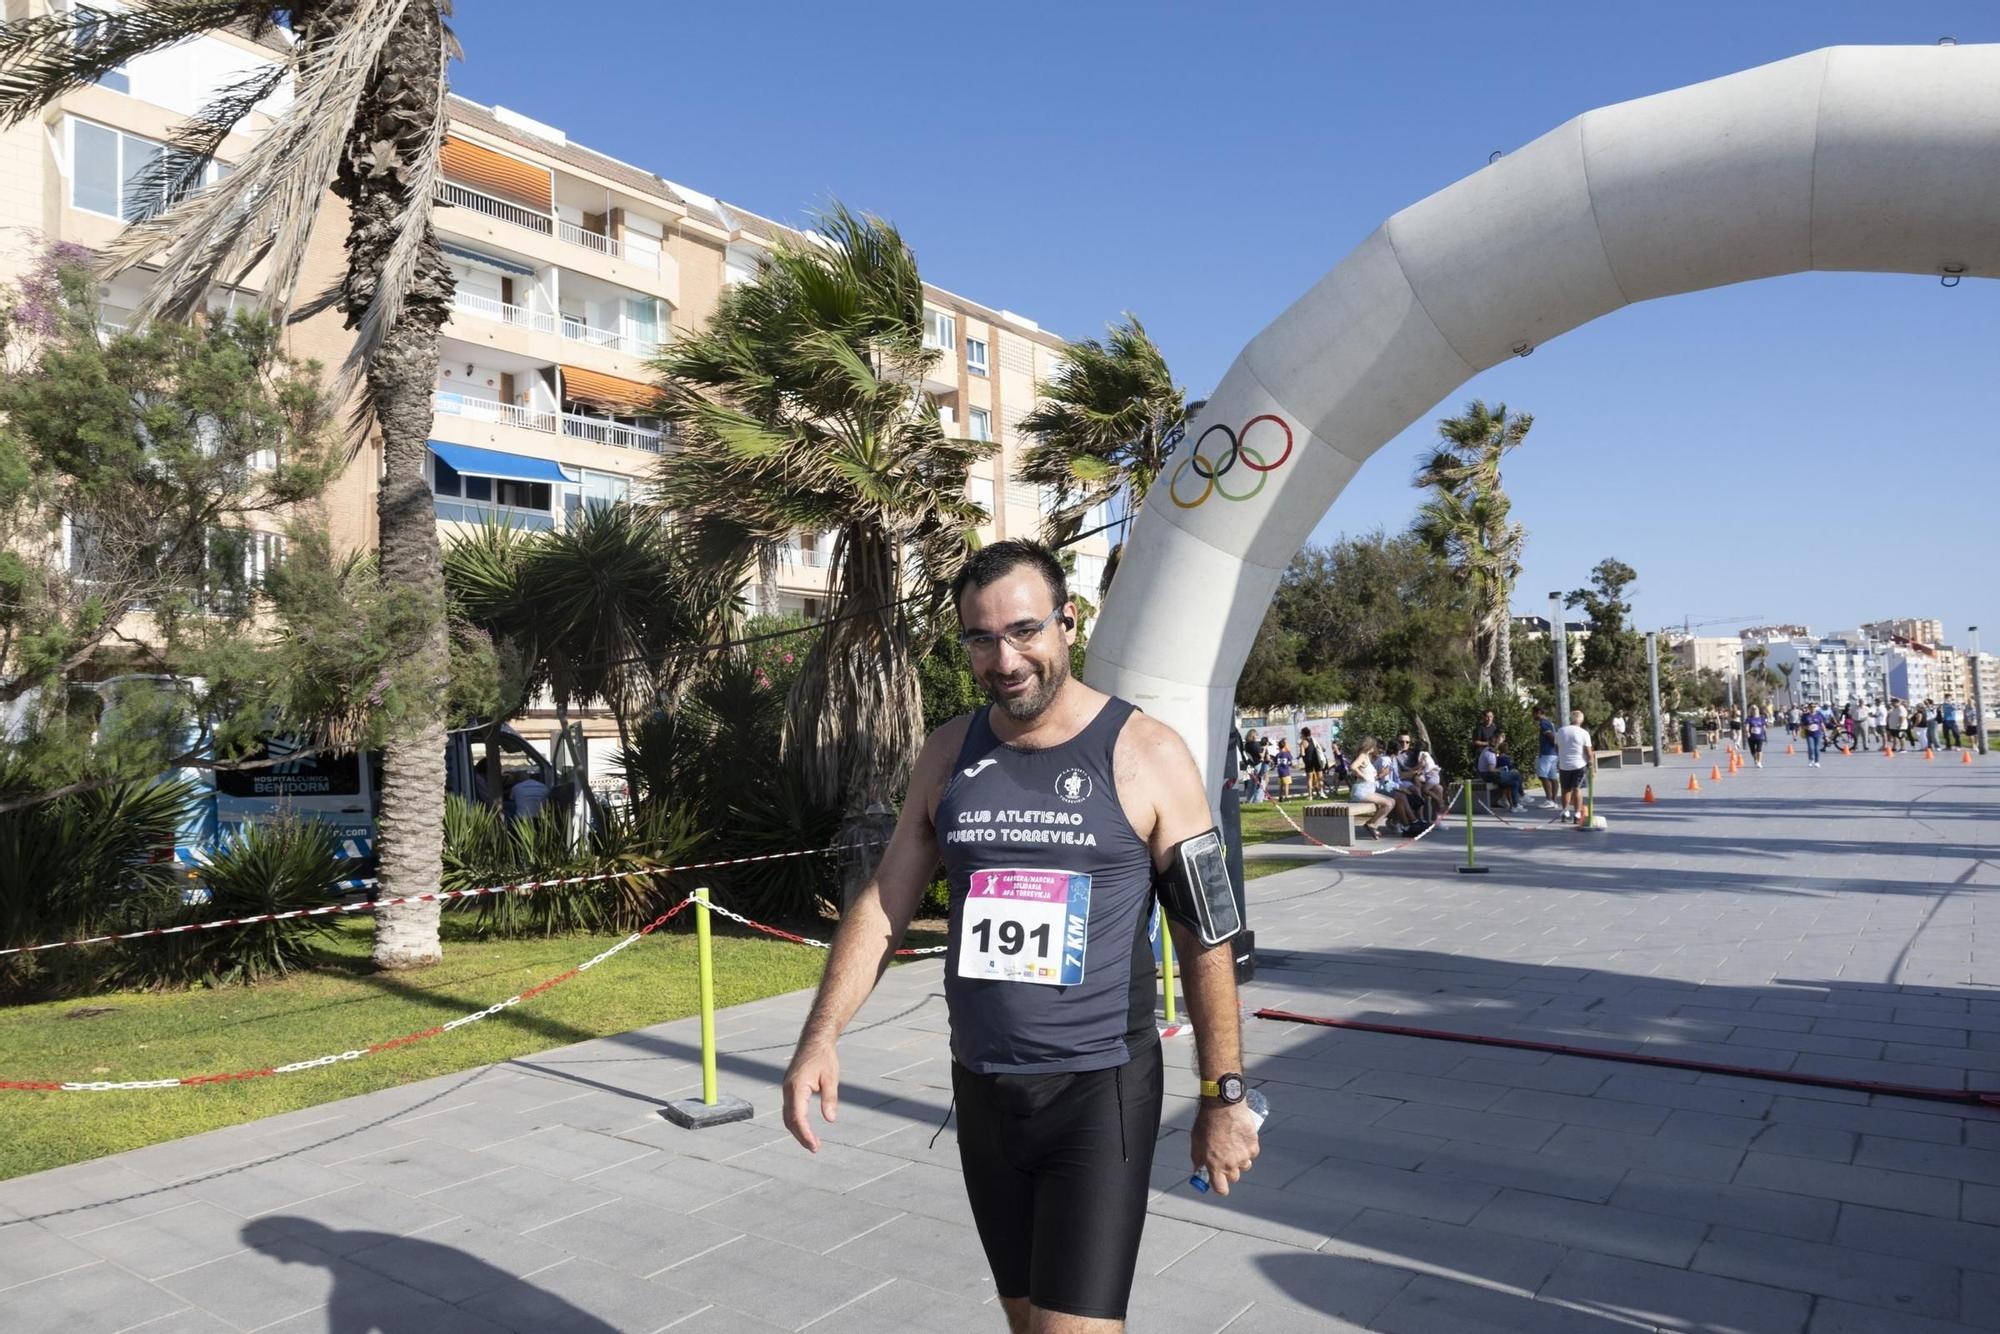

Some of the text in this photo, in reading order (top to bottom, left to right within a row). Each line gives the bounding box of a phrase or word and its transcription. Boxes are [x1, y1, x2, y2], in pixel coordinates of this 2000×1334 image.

[254, 783, 330, 793] BENIDORM
[958, 810, 1083, 826] CLUB ATLETISMO
[947, 828, 1097, 847] PUERTO TORREVIEJA
[972, 918, 1050, 958] 191
[1065, 914, 1085, 968] 7 KM
